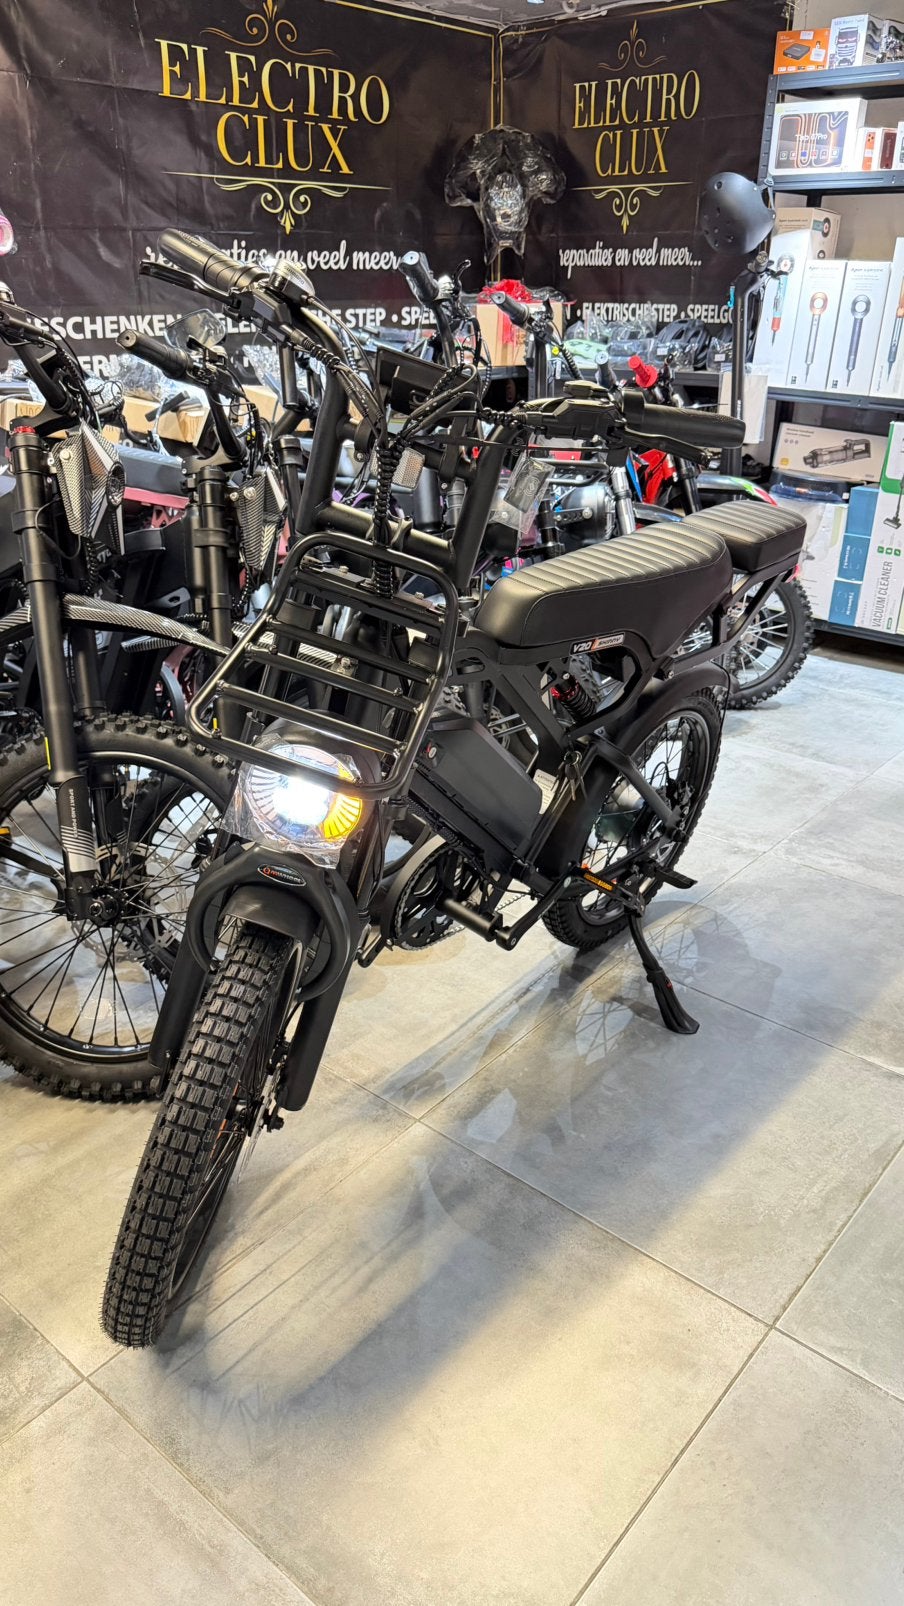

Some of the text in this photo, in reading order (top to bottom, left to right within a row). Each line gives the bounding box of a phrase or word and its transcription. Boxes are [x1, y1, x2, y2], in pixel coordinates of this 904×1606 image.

[155, 38, 390, 125] ELECTRO
[572, 69, 701, 129] ELECTRO
[216, 111, 354, 175] CLUX
[594, 126, 671, 177] CLUX
[307, 239, 350, 270] veel
[559, 240, 615, 279] reparaties
[615, 249, 632, 266] en
[632, 237, 659, 267] veel
[345, 307, 386, 329] STEP
[651, 303, 677, 322] STEP
[872, 596, 887, 628] VACUUM
[880, 560, 893, 597] CLEANER
[573, 641, 593, 653] V20
